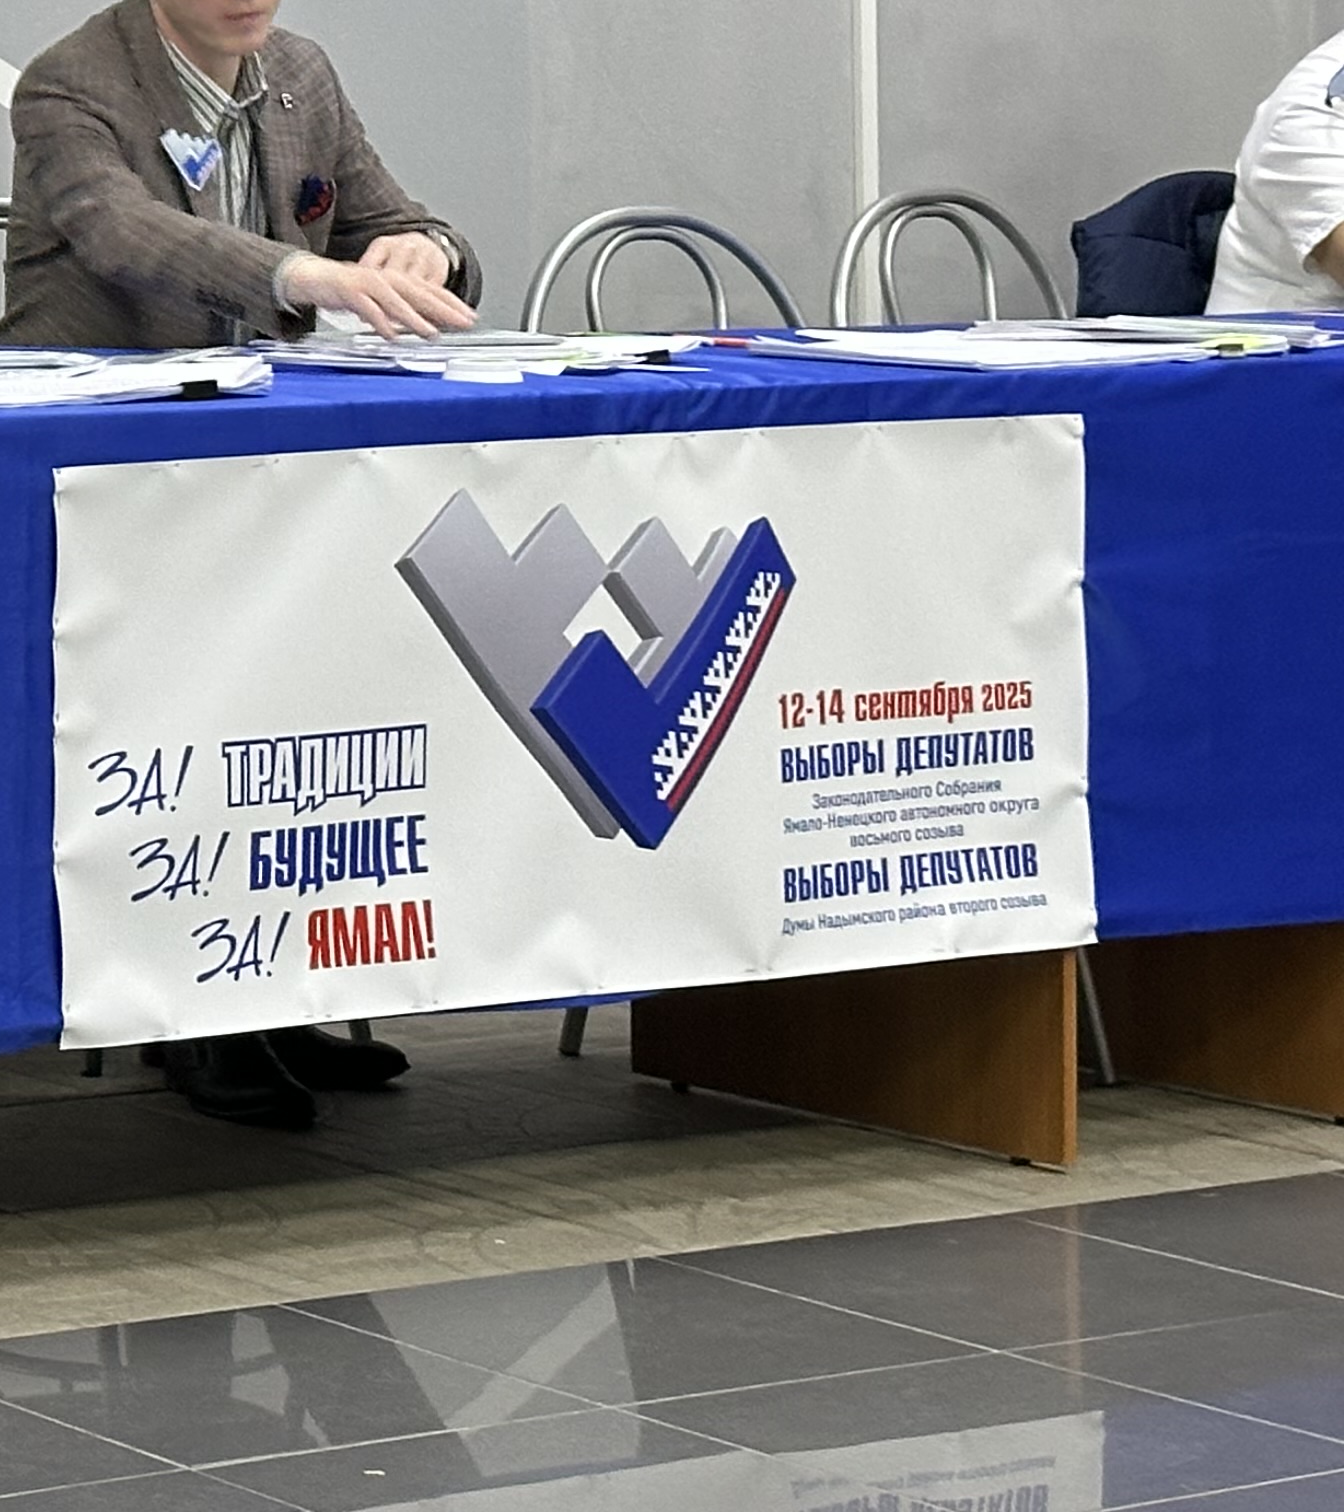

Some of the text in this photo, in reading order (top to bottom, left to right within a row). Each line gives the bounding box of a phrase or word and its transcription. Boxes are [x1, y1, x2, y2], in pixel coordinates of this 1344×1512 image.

[778, 681, 1033, 730] 12-14 сентября 2025
[88, 723, 427, 817] ЗА! ТРАДИЦИИ
[780, 727, 1034, 784] ВЫБОРЫ ДЕПУТАТОВ
[783, 796, 1040, 835] Ямало-Ненецкого автономного округа
[812, 779, 1002, 810] Законодательного Собрания
[129, 814, 429, 903] ЗА! БУДУЩЕЕ
[849, 823, 965, 848] восьмого созыва
[783, 842, 1039, 903] ВЫБОРЫ ДЕПУТАТОВ
[191, 899, 437, 984] ЗА! ЯМАЛ!
[782, 893, 1048, 937] Думы Надымского района второго созыва
